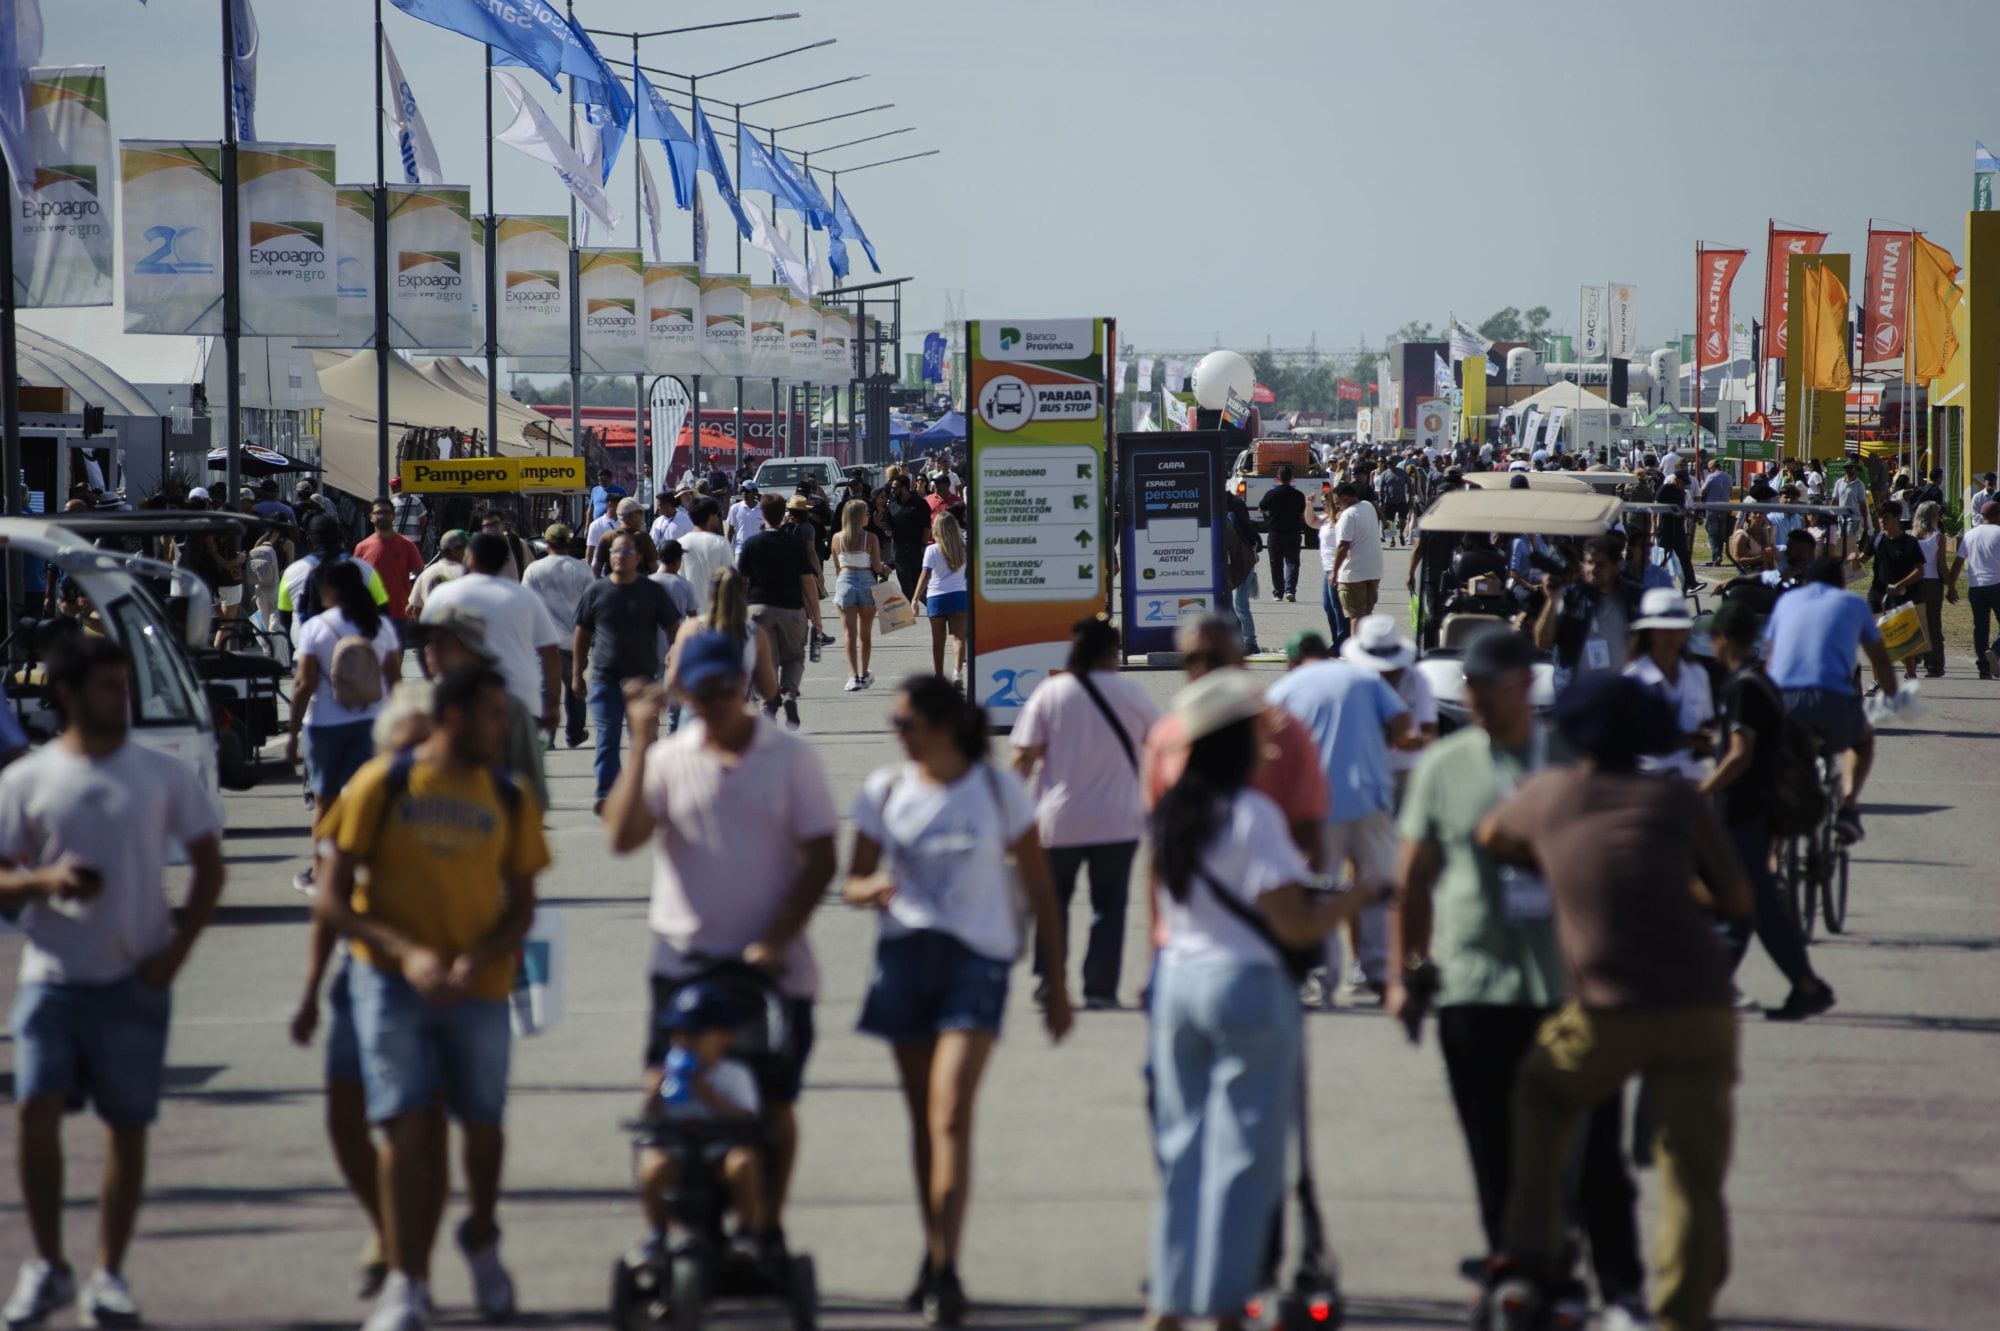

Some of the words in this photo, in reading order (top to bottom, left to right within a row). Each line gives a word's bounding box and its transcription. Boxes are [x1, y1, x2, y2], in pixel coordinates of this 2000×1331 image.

[22, 200, 99, 220] Expoagro
[68, 224, 101, 239] agro
[250, 249, 325, 267] Expoagro
[294, 269, 325, 282] agro
[1880, 240, 1903, 319] ALTINA
[398, 274, 462, 289] Expoagro
[435, 291, 462, 302] agro
[505, 290, 561, 304] Expoagro
[1709, 258, 1730, 326] ALTINA
[537, 304, 561, 316] agro
[587, 316, 636, 328] Expoagro
[650, 323, 694, 335] Expoagro
[705, 328, 746, 339] Expoagro
[1026, 333, 1057, 341] Banco
[1026, 342, 1074, 351] Provincia
[1039, 391, 1092, 401] PARADA
[1040, 403, 1061, 412] BUS
[1063, 403, 1092, 412] STOP
[1158, 462, 1185, 470] CARPA
[414, 466, 507, 485] Pampero
[984, 469, 1047, 477] TECNÓDROMO
[1145, 480, 1176, 488] ESPACIO
[1014, 489, 1026, 497] DE
[1145, 487, 1199, 502] personal
[984, 498, 1033, 506] MÁQUINAS
[1170, 502, 1199, 510] AGTECH
[984, 506, 1052, 514] CONSTRUCCIÓN
[1009, 514, 1040, 522] DEERE
[984, 535, 1037, 545] GANADERÍA
[1152, 548, 1195, 556] AUDITORIO
[985, 560, 1044, 569] SANITARIOS/
[985, 569, 1020, 577] PUESTO
[985, 577, 1046, 586] HIDRATACIÓN
